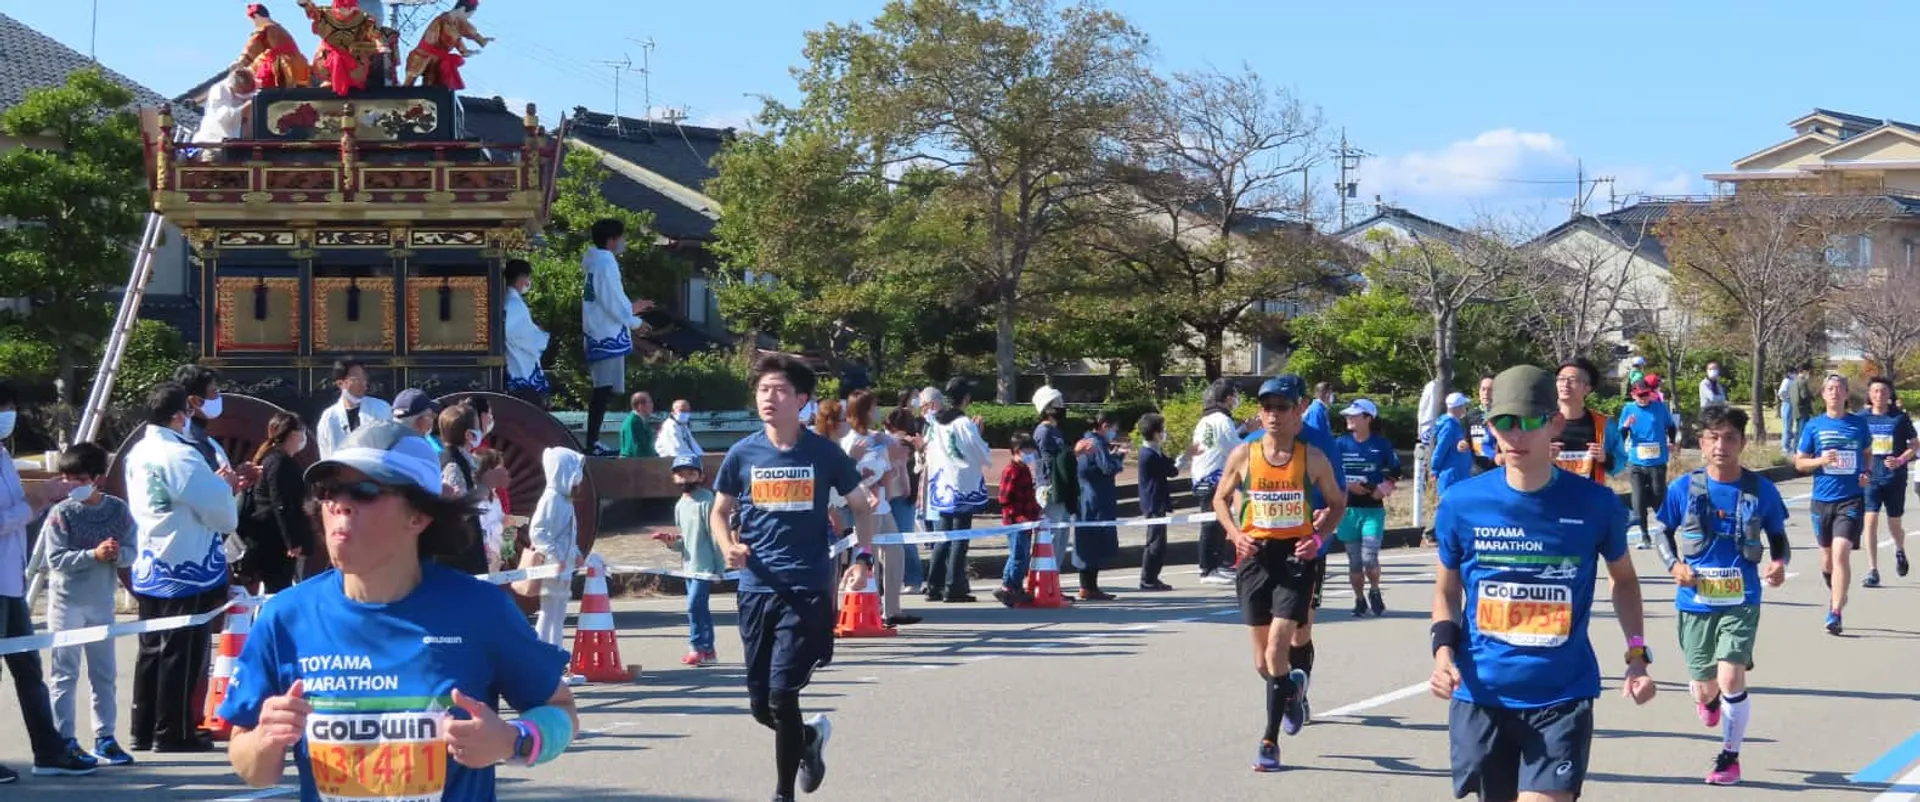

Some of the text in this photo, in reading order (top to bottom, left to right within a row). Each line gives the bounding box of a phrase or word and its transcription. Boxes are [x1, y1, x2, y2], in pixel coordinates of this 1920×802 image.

[754, 469, 810, 479] GOLDWIN
[1474, 527, 1525, 538] TOYAMA
[1475, 540, 1543, 551] MARATHON
[1484, 584, 1567, 601] GOLDWIN
[299, 655, 372, 673] TOYAMA
[302, 675, 399, 692] MARATHON
[312, 718, 437, 741] GOLDWIN
